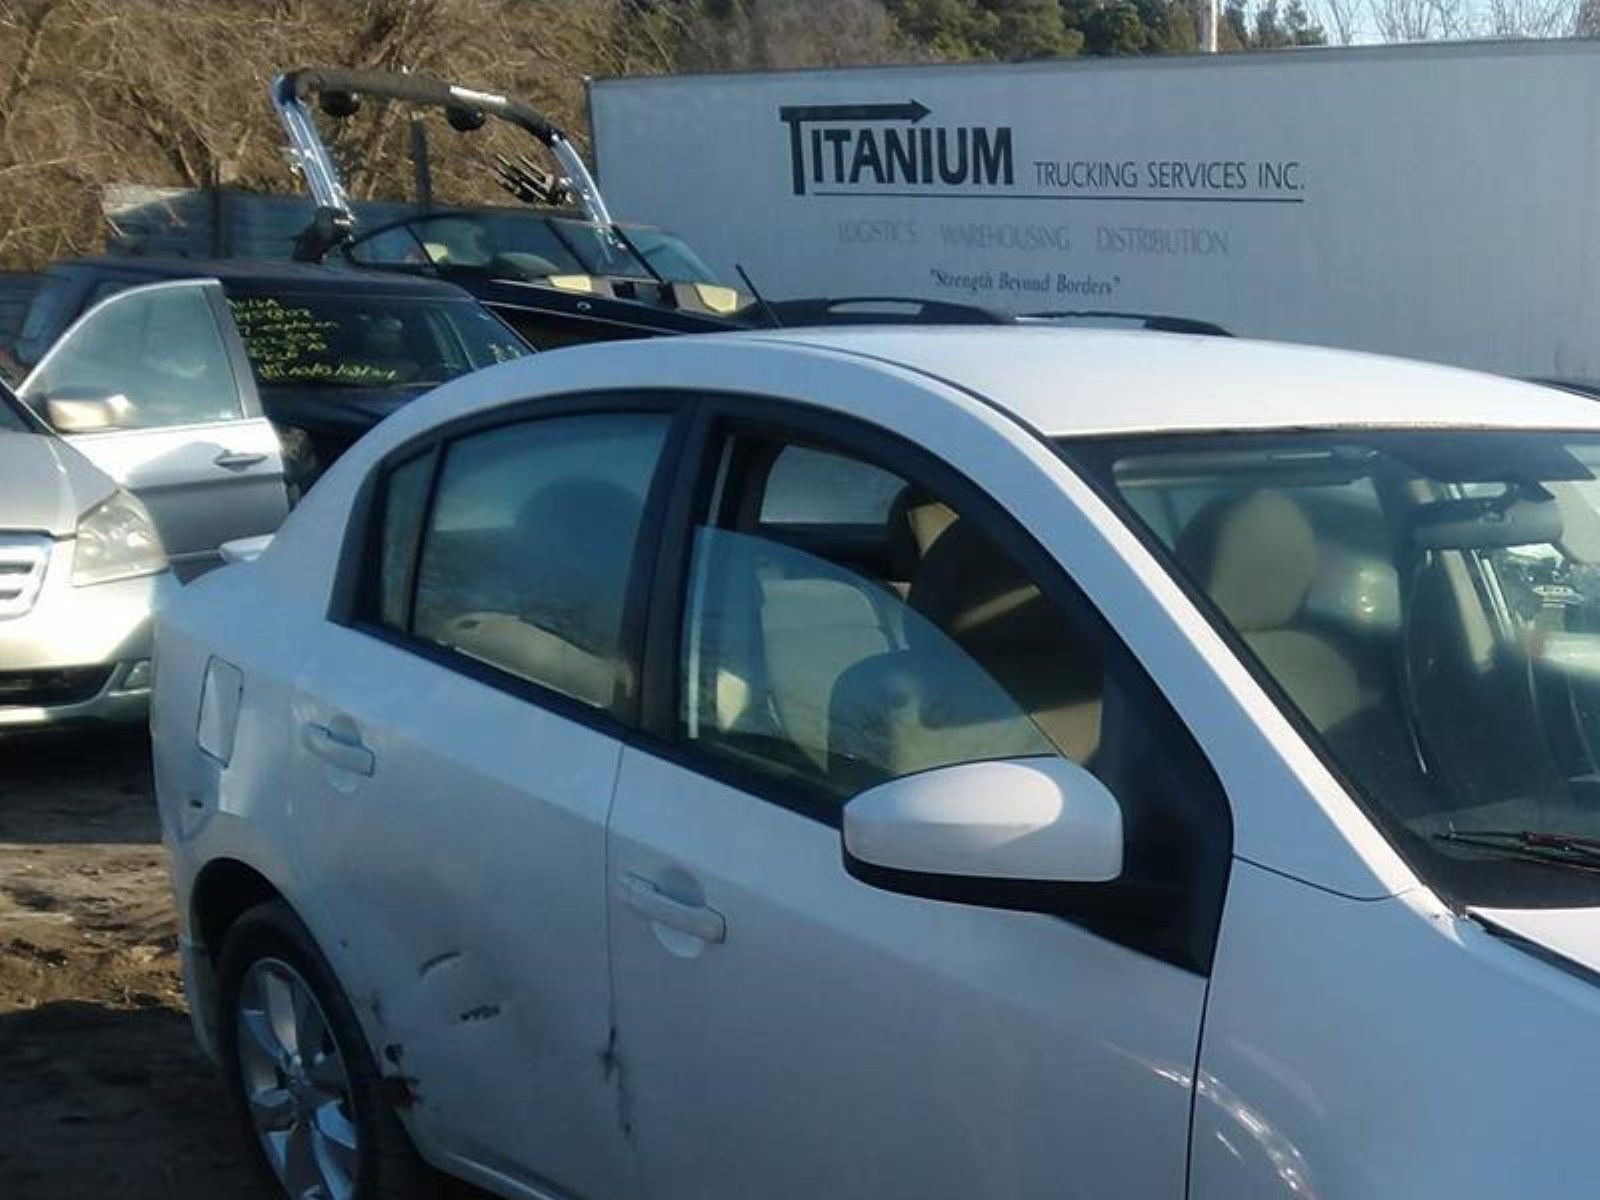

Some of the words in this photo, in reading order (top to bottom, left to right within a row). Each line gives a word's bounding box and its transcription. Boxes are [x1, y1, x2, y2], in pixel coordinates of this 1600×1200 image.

[779, 99, 1014, 196] TITANIUM
[1034, 160, 1139, 189] TRUCKING
[1147, 160, 1248, 190] SERVICES
[1258, 161, 1305, 191] INC.
[940, 222, 1072, 252] WAREHOUSING
[1095, 225, 1230, 256] DISTRIBUTION
